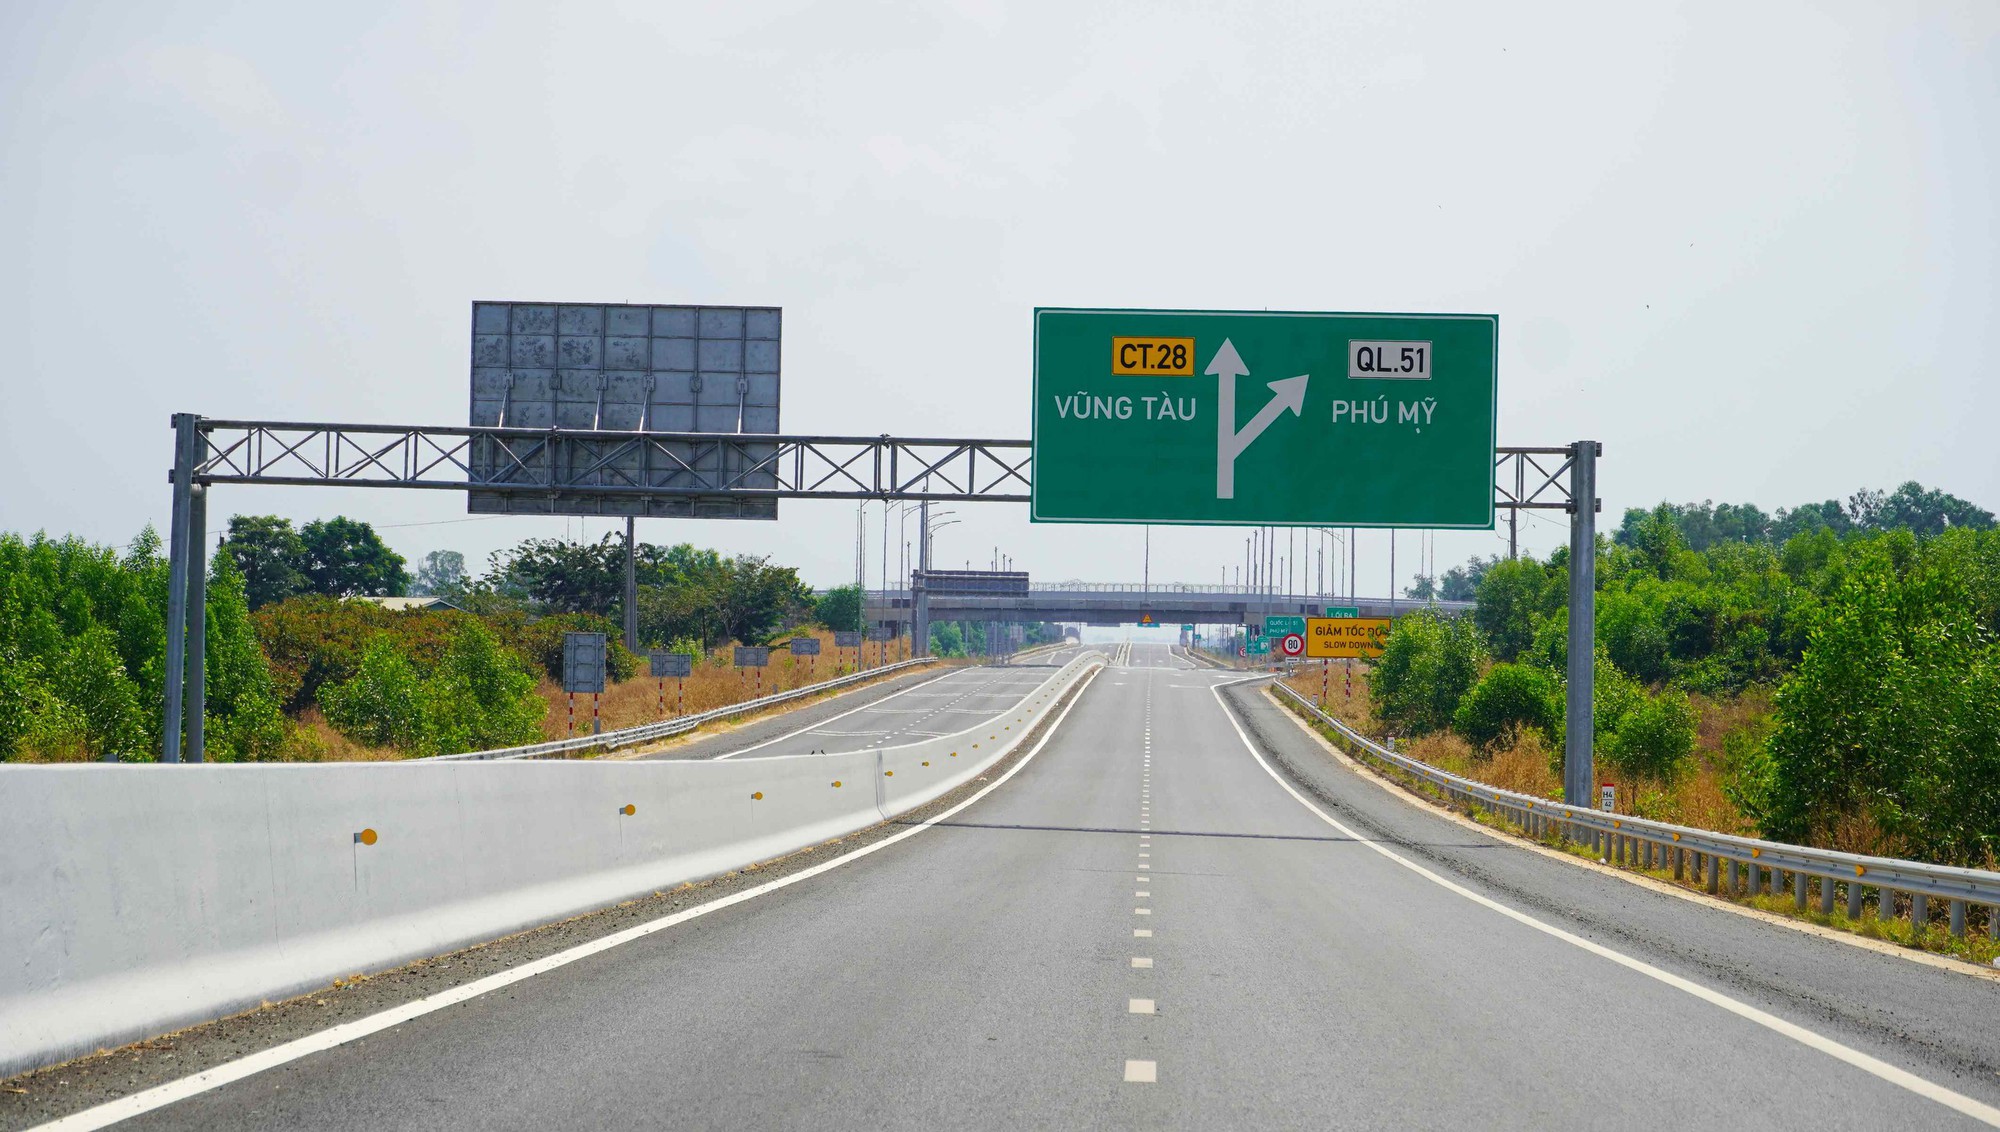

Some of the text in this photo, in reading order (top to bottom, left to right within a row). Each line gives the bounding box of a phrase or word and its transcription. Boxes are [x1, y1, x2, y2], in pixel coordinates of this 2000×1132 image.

[1119, 343, 1188, 371] CT.28
[1356, 346, 1426, 374] QL.51
[1054, 391, 1197, 421] VŨNG TÀU
[1331, 394, 1438, 434] PHÚ MỸ
[1288, 639, 1298, 649] 80
[1315, 624, 1342, 636] GIẢM
[1345, 624, 1367, 636] TỐC
[1324, 641, 1373, 649] SLOW DOWN
